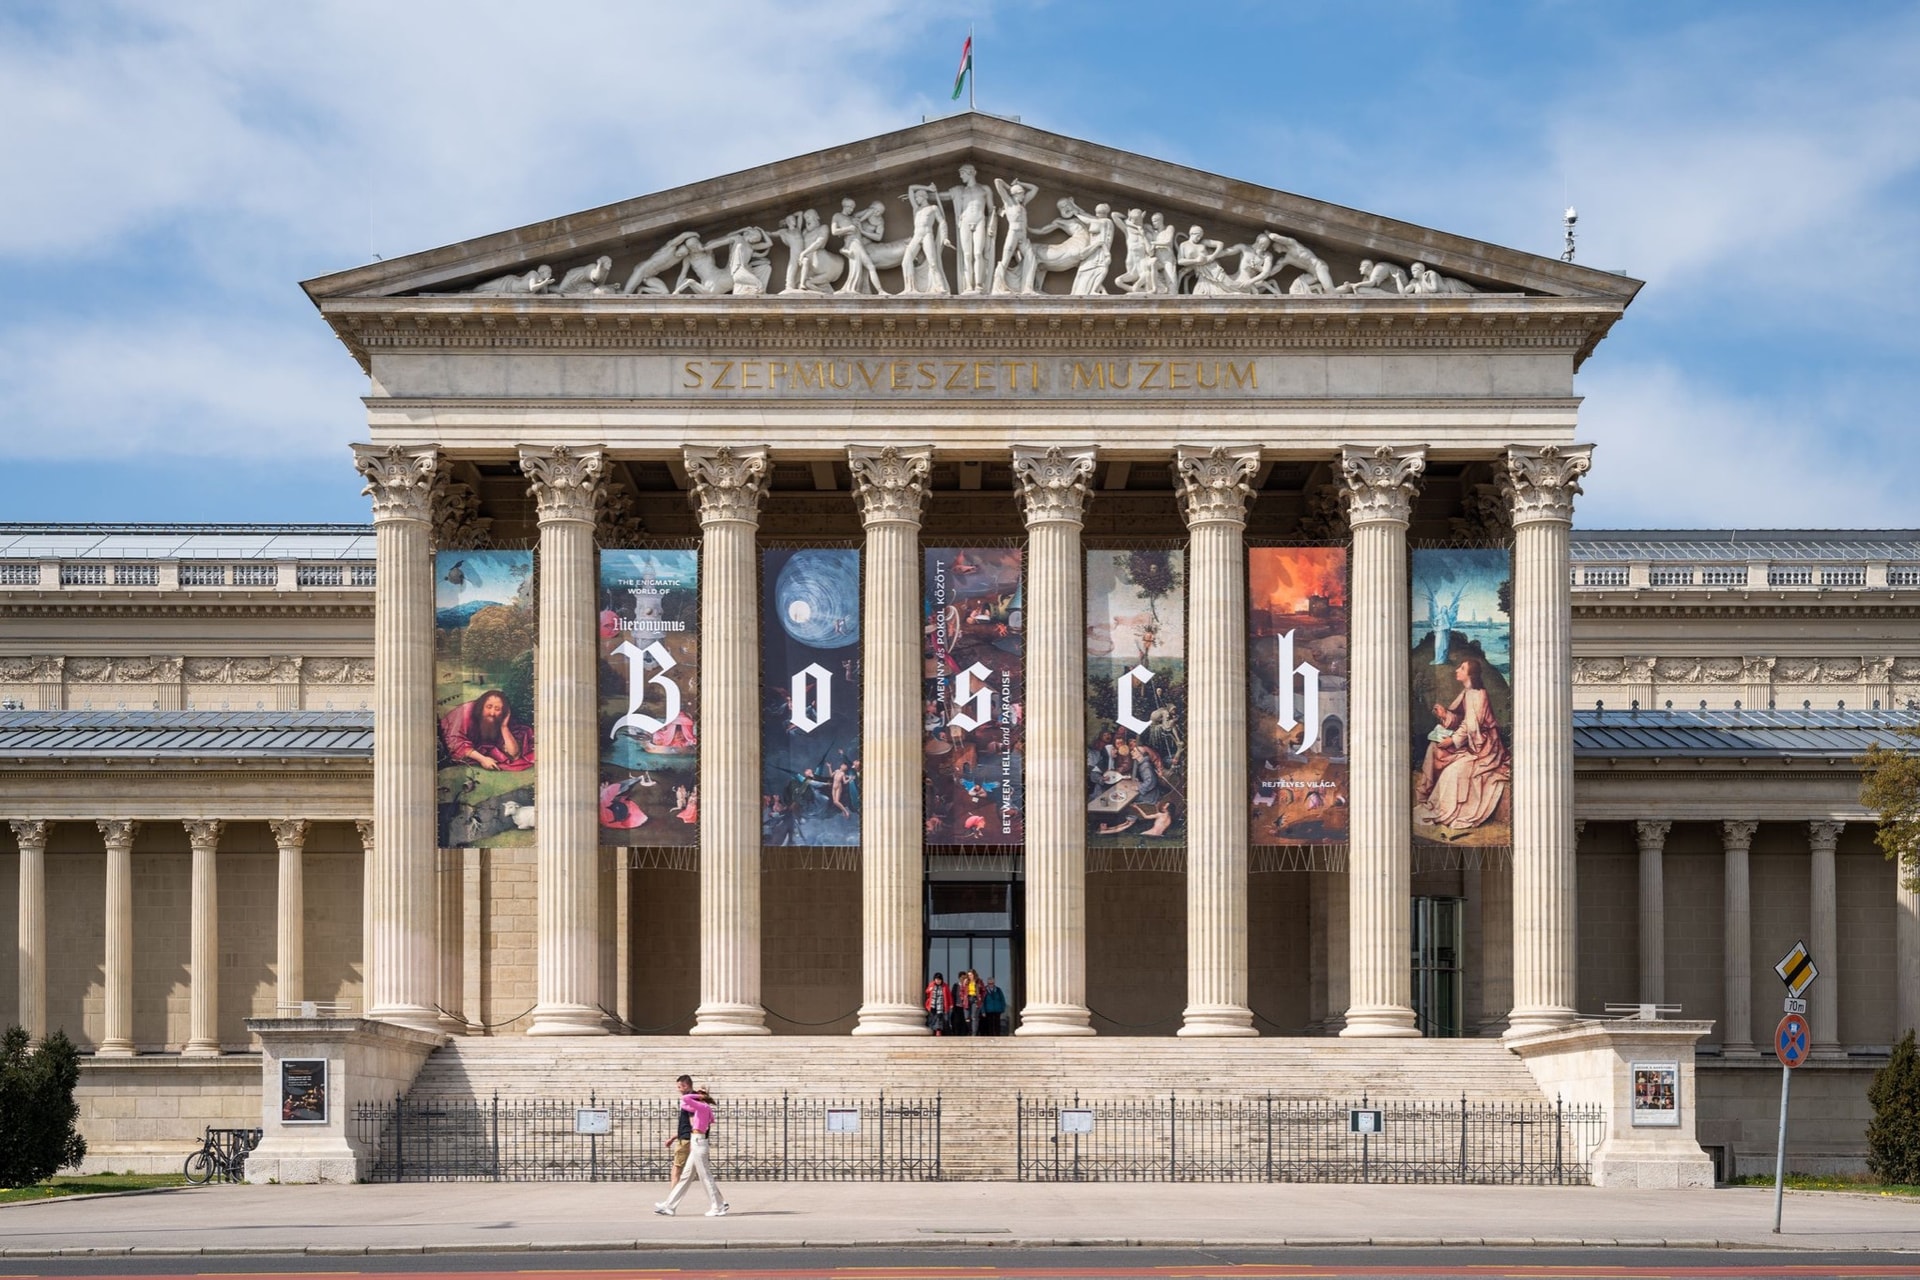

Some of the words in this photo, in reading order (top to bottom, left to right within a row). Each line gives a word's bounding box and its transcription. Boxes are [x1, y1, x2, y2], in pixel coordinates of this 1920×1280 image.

[934, 559, 946, 605] KÖZÖTT
[612, 616, 686, 635] Hieronymus
[936, 608, 946, 645] POKOL
[936, 648, 946, 659] és
[609, 640, 681, 740] B
[936, 662, 946, 703] MENNY
[1002, 670, 1011, 724] PARADISE
[1000, 727, 1011, 746] and
[1002, 748, 1011, 776] HELL
[1261, 778, 1305, 788] REJTÉLYES
[1306, 779, 1336, 788] VILÁGA
[1002, 779, 1011, 834] BETWEEN
